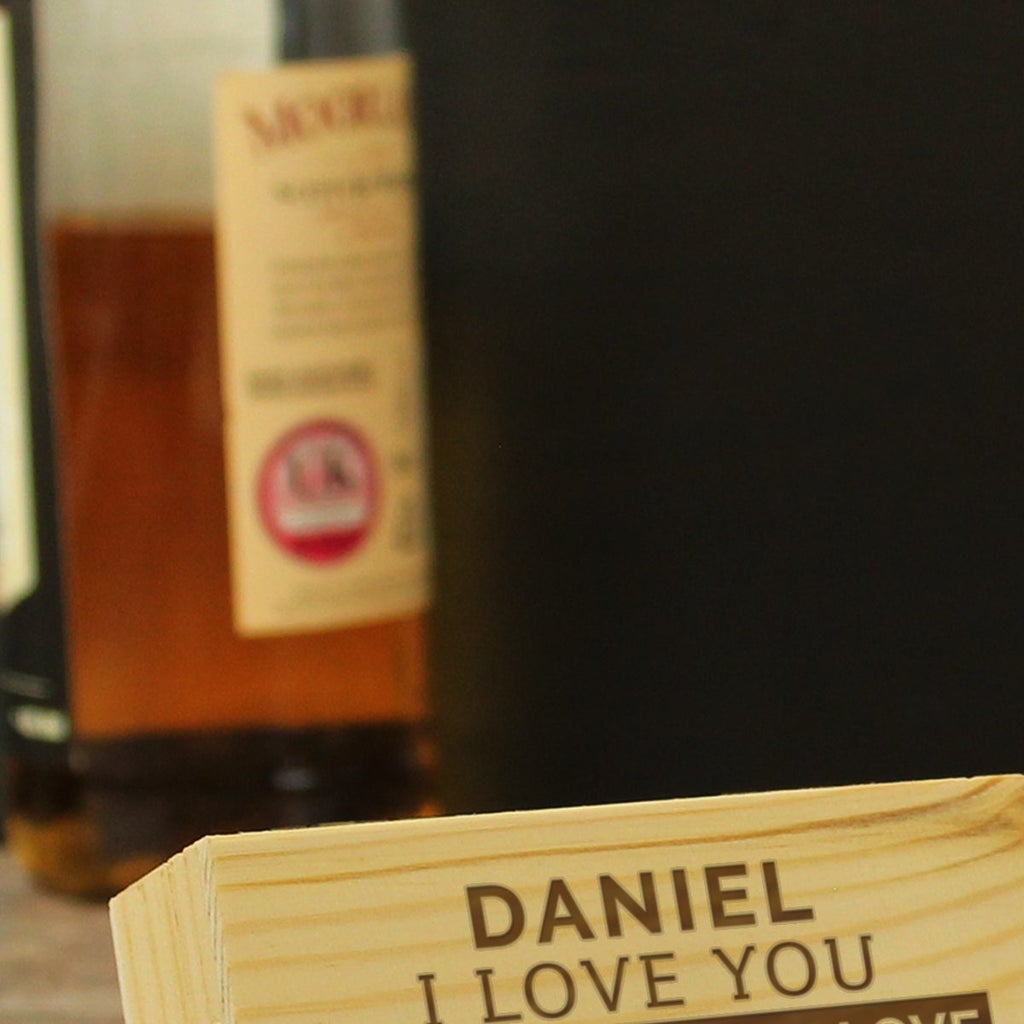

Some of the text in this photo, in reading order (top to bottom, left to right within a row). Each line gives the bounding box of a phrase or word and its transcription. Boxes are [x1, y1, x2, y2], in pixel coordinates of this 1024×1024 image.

[465, 861, 814, 949] DANIEL
[475, 953, 686, 1023] LOVE
[713, 935, 876, 1001] YOU
